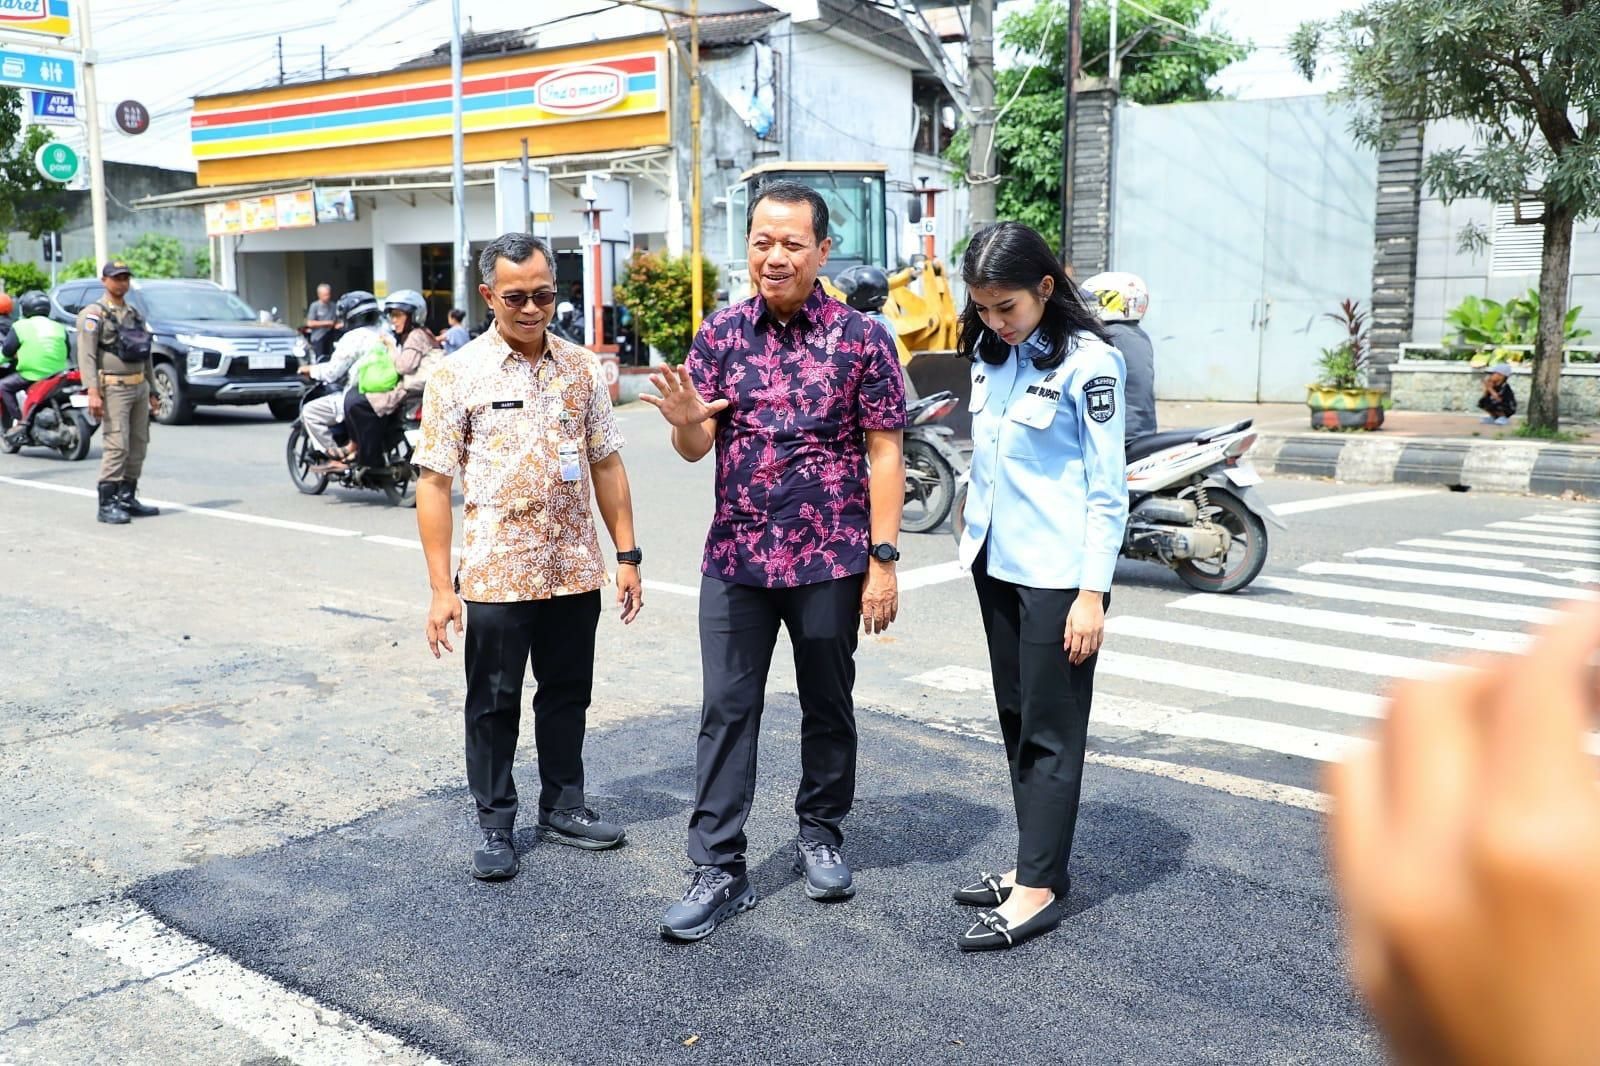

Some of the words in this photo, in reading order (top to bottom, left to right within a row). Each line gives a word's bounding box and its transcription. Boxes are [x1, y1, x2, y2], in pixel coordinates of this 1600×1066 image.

[0, 0, 40, 12] aret
[50, 95, 69, 105] ATM
[925, 219, 934, 232] 6
